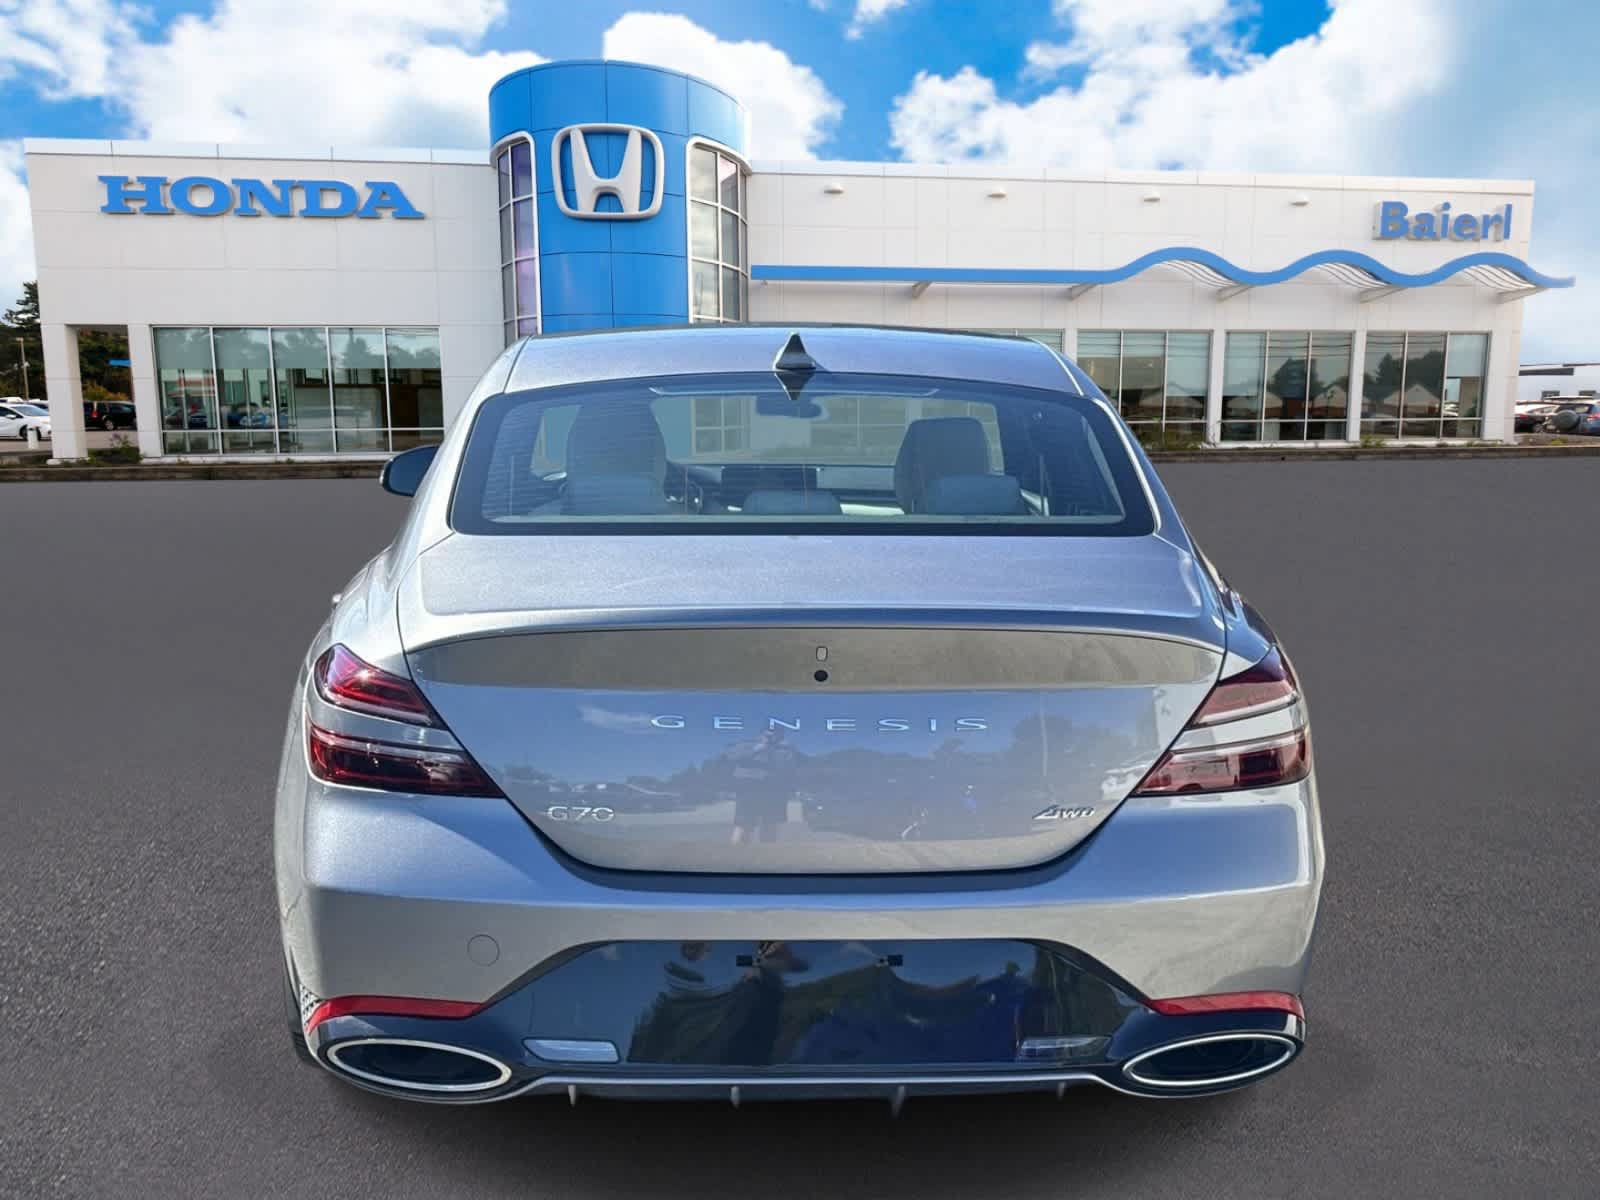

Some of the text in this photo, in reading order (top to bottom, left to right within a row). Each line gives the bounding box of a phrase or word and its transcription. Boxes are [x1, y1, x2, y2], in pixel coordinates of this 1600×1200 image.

[97, 175, 425, 219] HONDA
[1379, 200, 1513, 240] Baierl
[650, 714, 989, 731] GENESIS
[546, 805, 615, 821] G70
